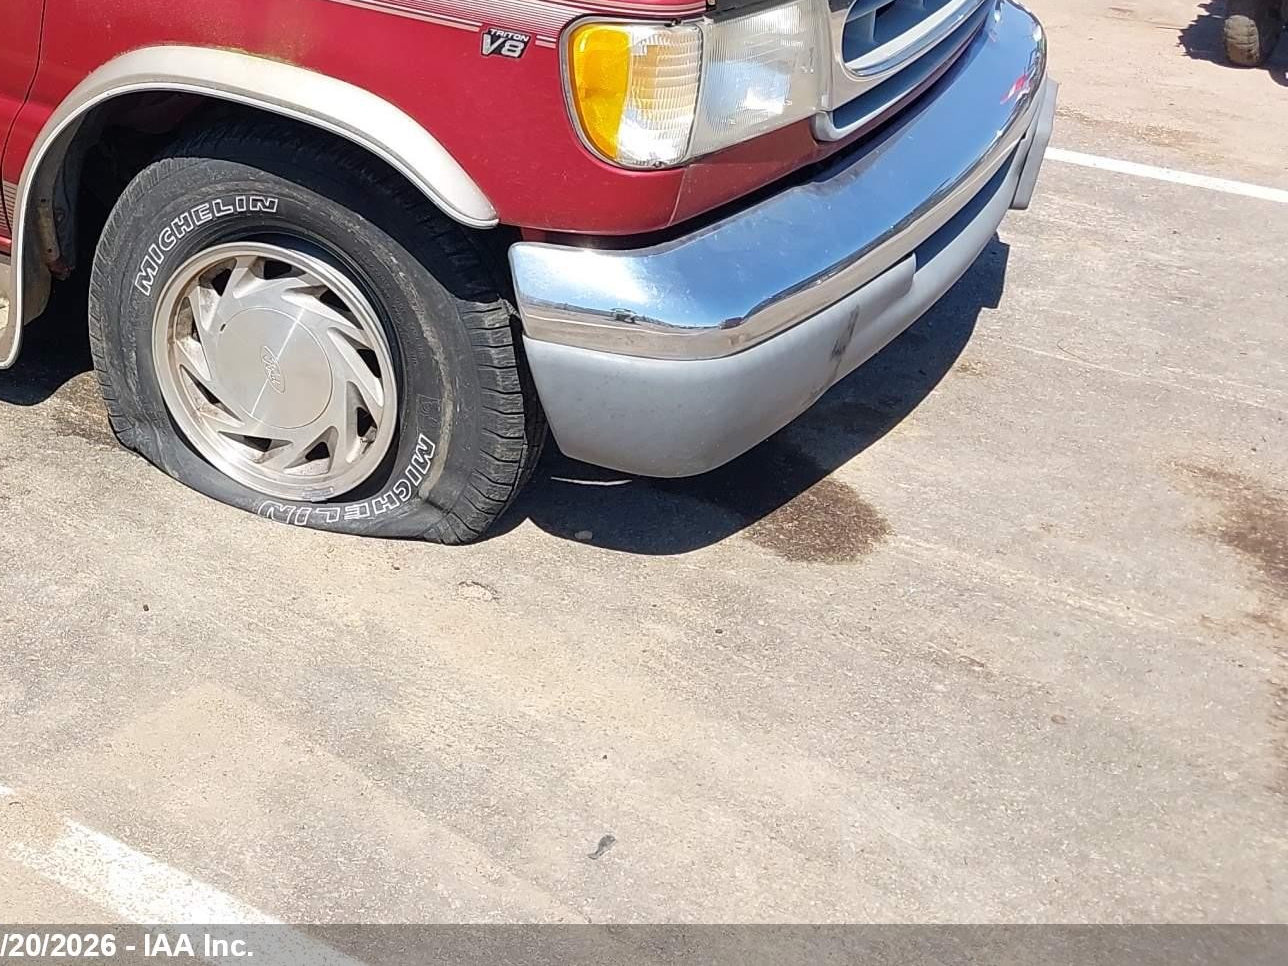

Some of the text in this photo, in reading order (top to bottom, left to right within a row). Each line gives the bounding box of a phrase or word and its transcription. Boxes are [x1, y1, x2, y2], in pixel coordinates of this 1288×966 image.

[482, 33, 525, 58] V8
[489, 28, 530, 42] TRITON
[134, 195, 279, 296] MICHELIN
[257, 433, 436, 526] MICHELIN
